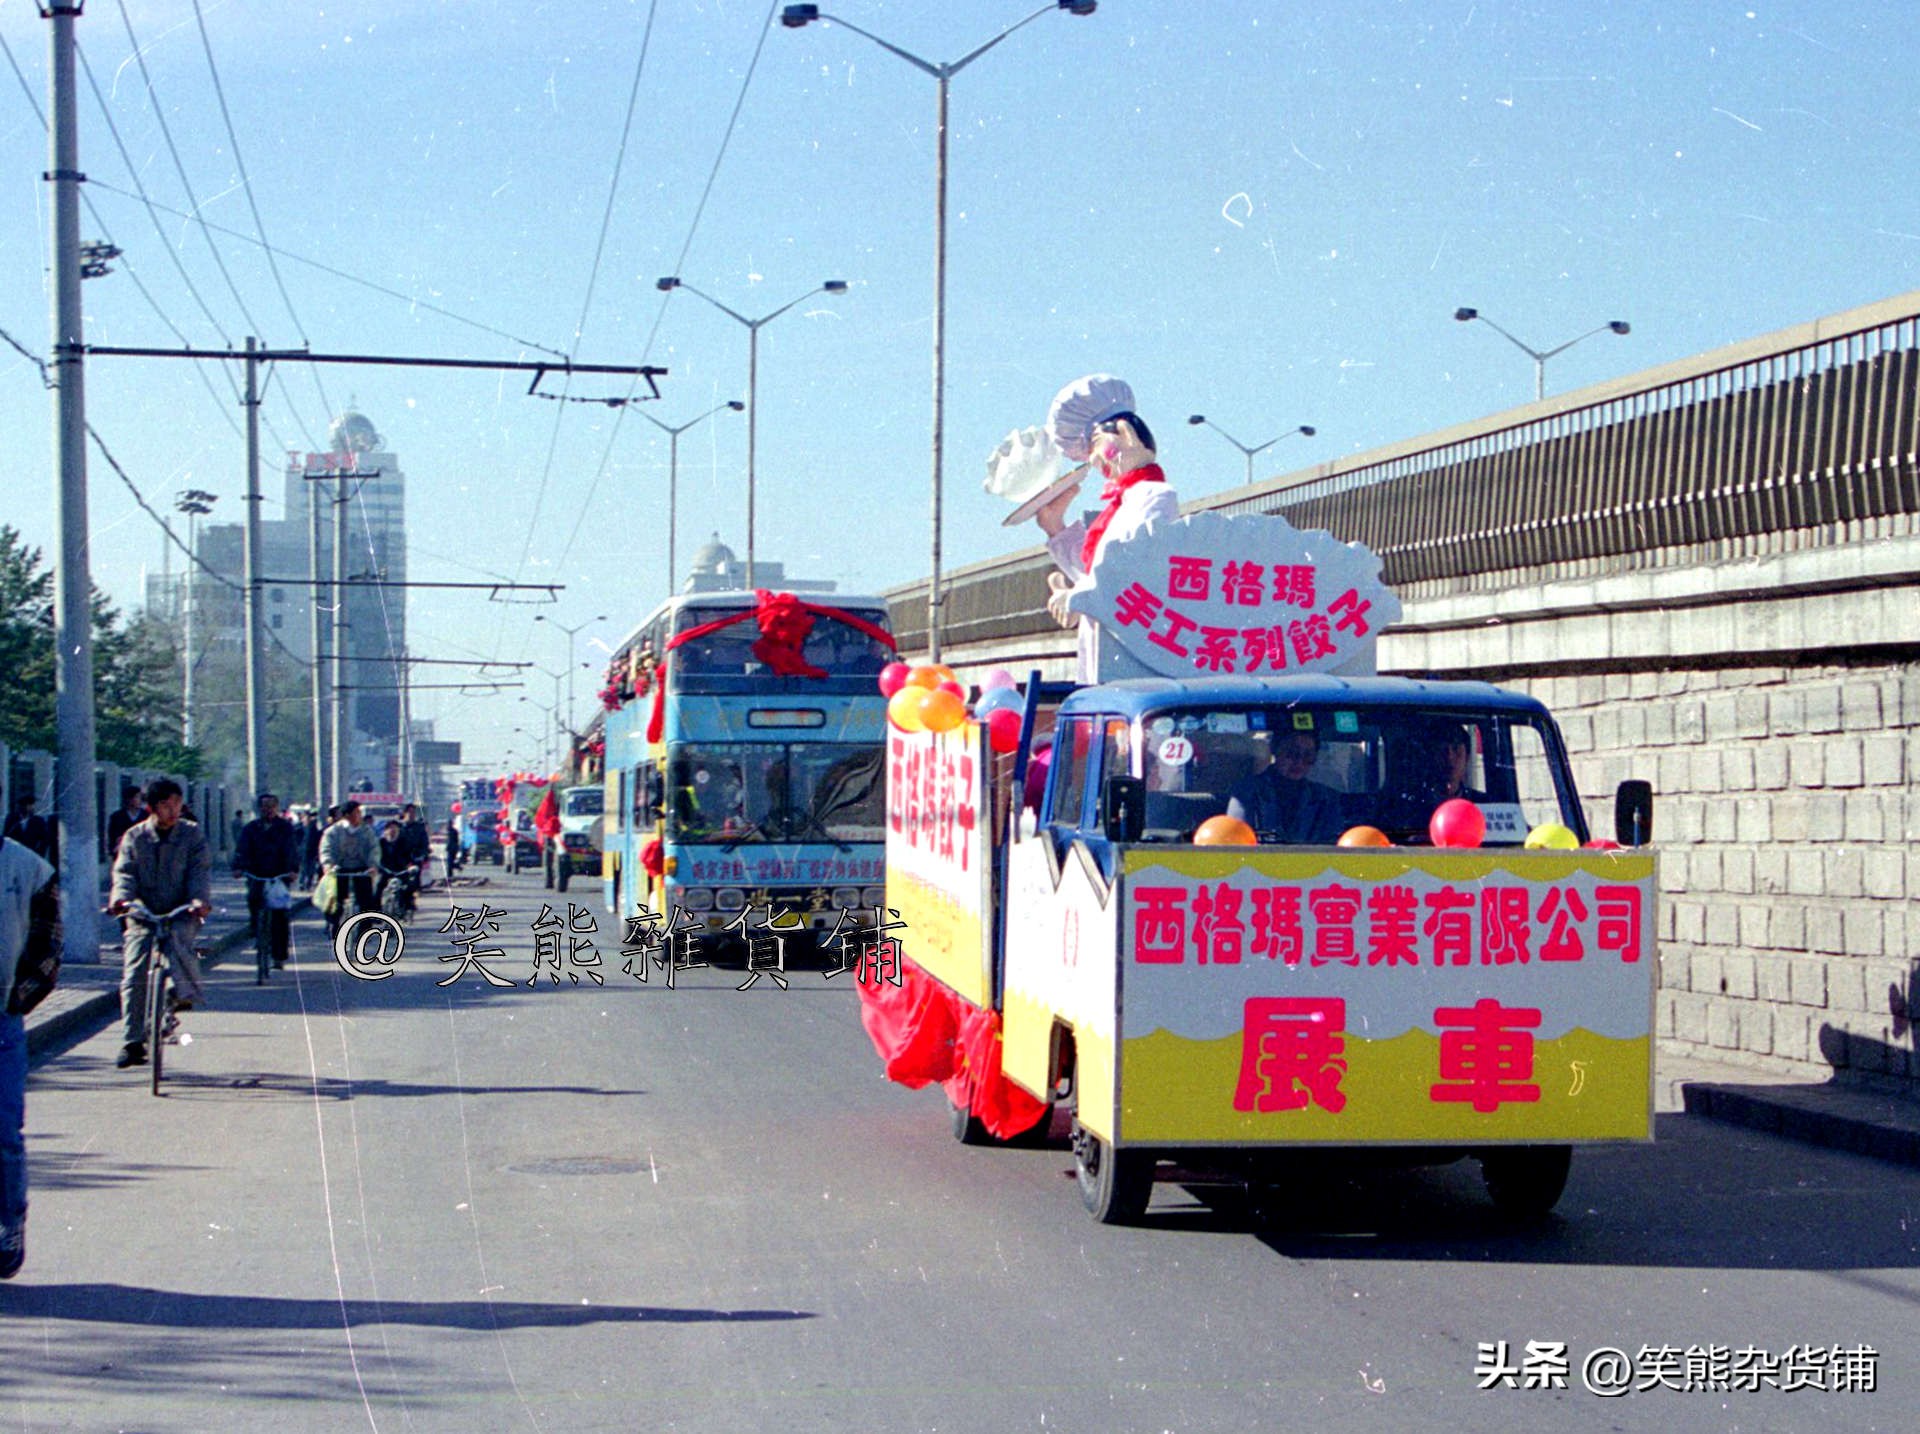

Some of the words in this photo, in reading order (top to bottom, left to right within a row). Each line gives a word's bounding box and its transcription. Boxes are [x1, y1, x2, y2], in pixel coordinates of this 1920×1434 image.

[1168, 555, 1317, 610] 西格瑪
[1113, 581, 1373, 674] 手工系列餃子
[1164, 742, 1186, 760] 21
[1133, 882, 1643, 968] 西格瑪實業有限公司
[1232, 996, 1544, 1115] 展車
